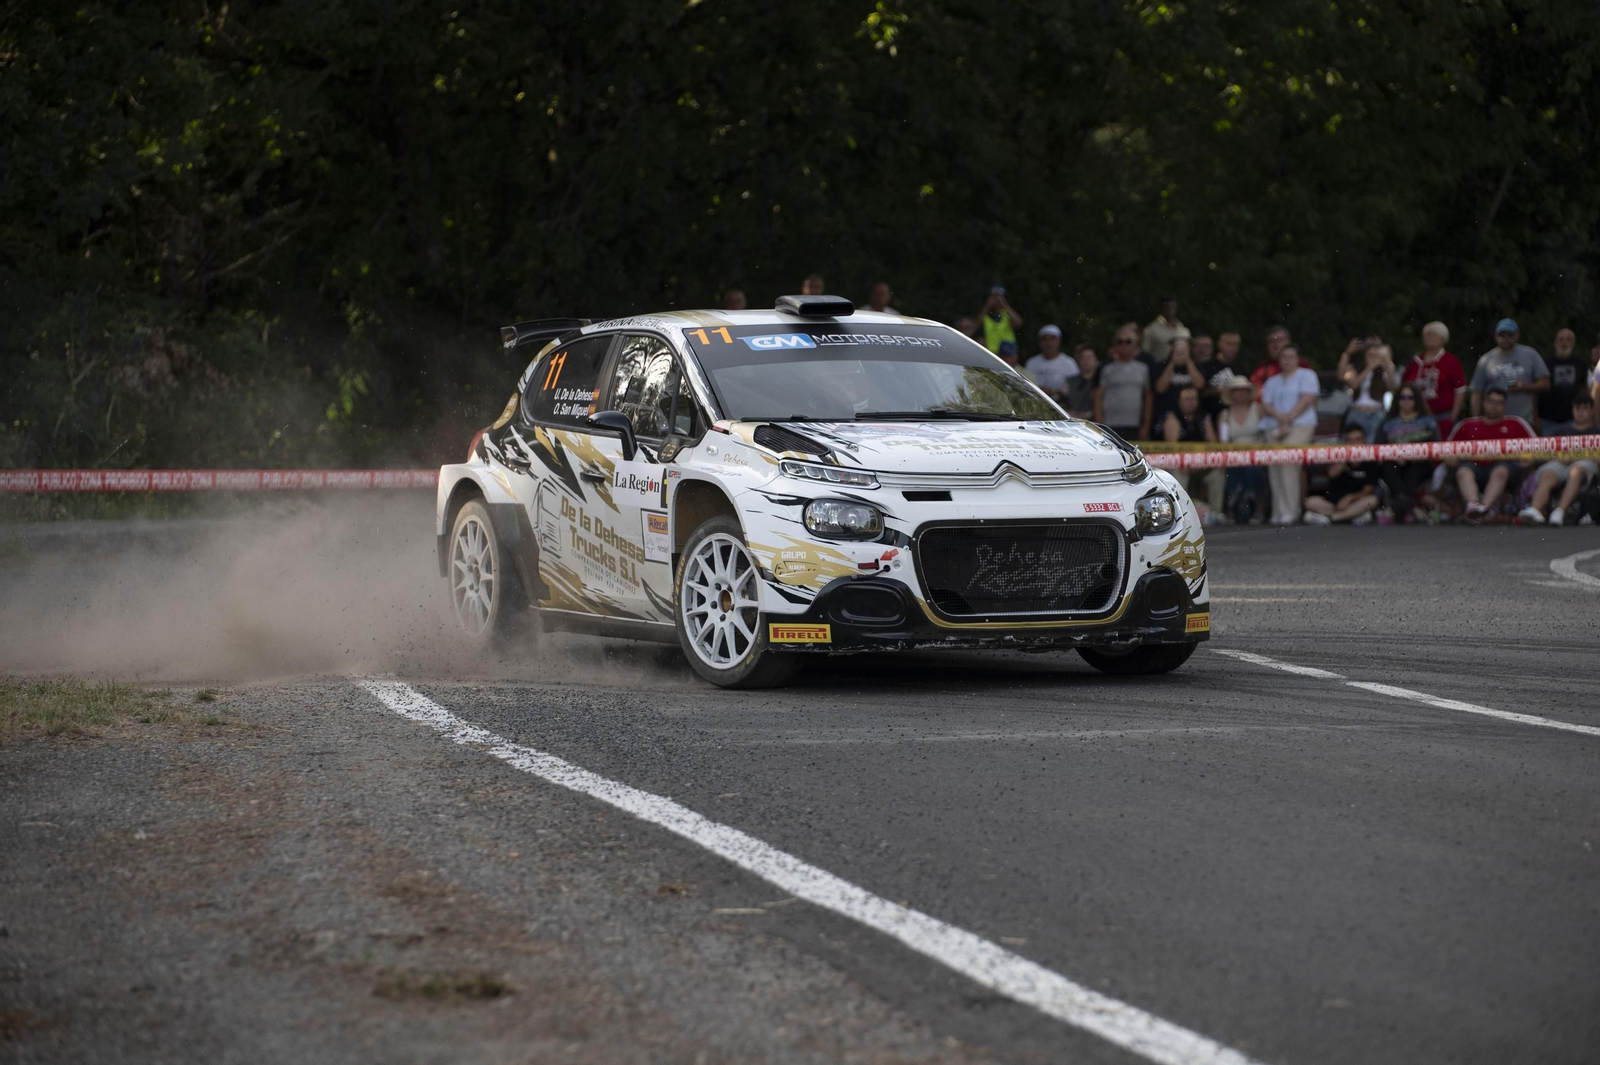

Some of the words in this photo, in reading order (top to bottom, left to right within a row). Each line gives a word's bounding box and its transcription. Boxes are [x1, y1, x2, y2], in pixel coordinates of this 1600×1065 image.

[689, 327, 733, 345] 11
[812, 334, 943, 347] MOTORSPORT
[543, 351, 568, 391] 11
[561, 389, 569, 400] De
[576, 389, 594, 401] Dehesa
[560, 403, 572, 415] San
[572, 404, 590, 418] Miguel
[1183, 452, 1222, 467] PUBLICO
[1227, 450, 1251, 466] ZONA
[1254, 448, 1304, 465] PROHIBIDO
[1307, 446, 1347, 463] PUBLICO
[1350, 445, 1375, 461] ZONA
[1378, 443, 1429, 460] PROHIBIDO
[1432, 441, 1473, 457] PUBLICO
[1476, 440, 1501, 454] ZONA
[1505, 437, 1557, 454] PROHIBIDO
[1561, 435, 1600, 450] PUBLICO
[724, 453, 749, 467] Dehesa
[105, 472, 149, 489] PROHIBIDO
[615, 471, 627, 489] La
[629, 473, 660, 495] Región
[1090, 503, 1105, 511] 5332
[1108, 503, 1120, 511] BCL
[561, 495, 577, 523] De
[580, 507, 592, 533] la
[595, 516, 645, 566] Dehesa
[570, 525, 617, 573] Trucks
[781, 551, 807, 559] GRUPO
[571, 548, 604, 576] COMPRAVENTA
[613, 575, 637, 595] CAMIONES
[1187, 616, 1209, 629] PIRELLI
[773, 627, 828, 639] PIRELLI
